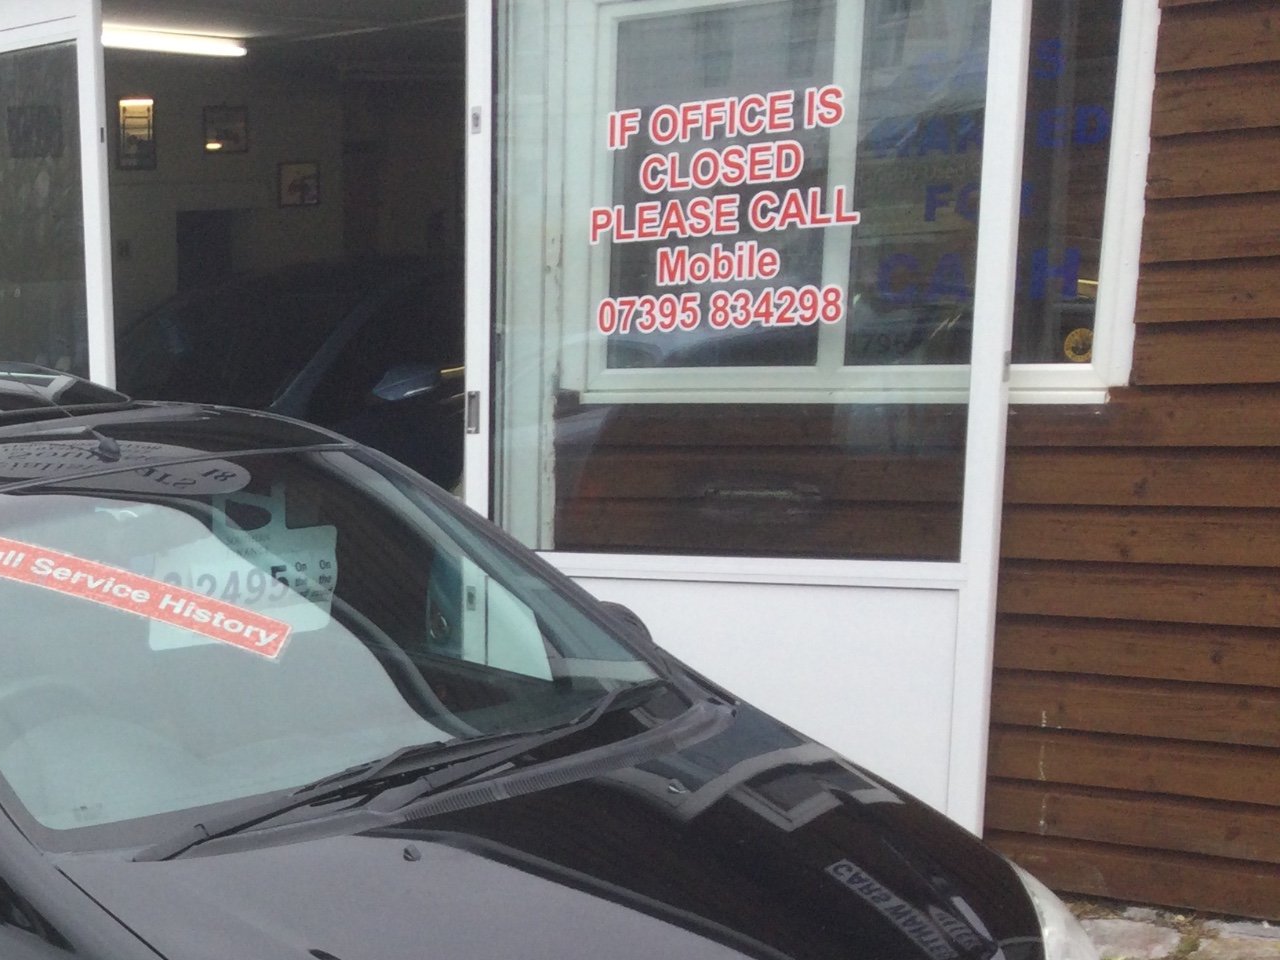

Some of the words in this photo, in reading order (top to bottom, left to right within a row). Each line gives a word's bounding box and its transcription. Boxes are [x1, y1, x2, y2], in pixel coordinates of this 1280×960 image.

[608, 109, 641, 149] IF
[649, 90, 794, 146] OFFICE
[804, 84, 844, 129] IS
[640, 140, 804, 193] CLOSED
[590, 194, 740, 244] PLEASE
[748, 184, 860, 231] CALL
[656, 241, 781, 286] Mobile
[597, 291, 701, 335] 07395
[708, 284, 844, 329] 834298
[29, 556, 152, 604] Service
[157, 593, 279, 647] History
